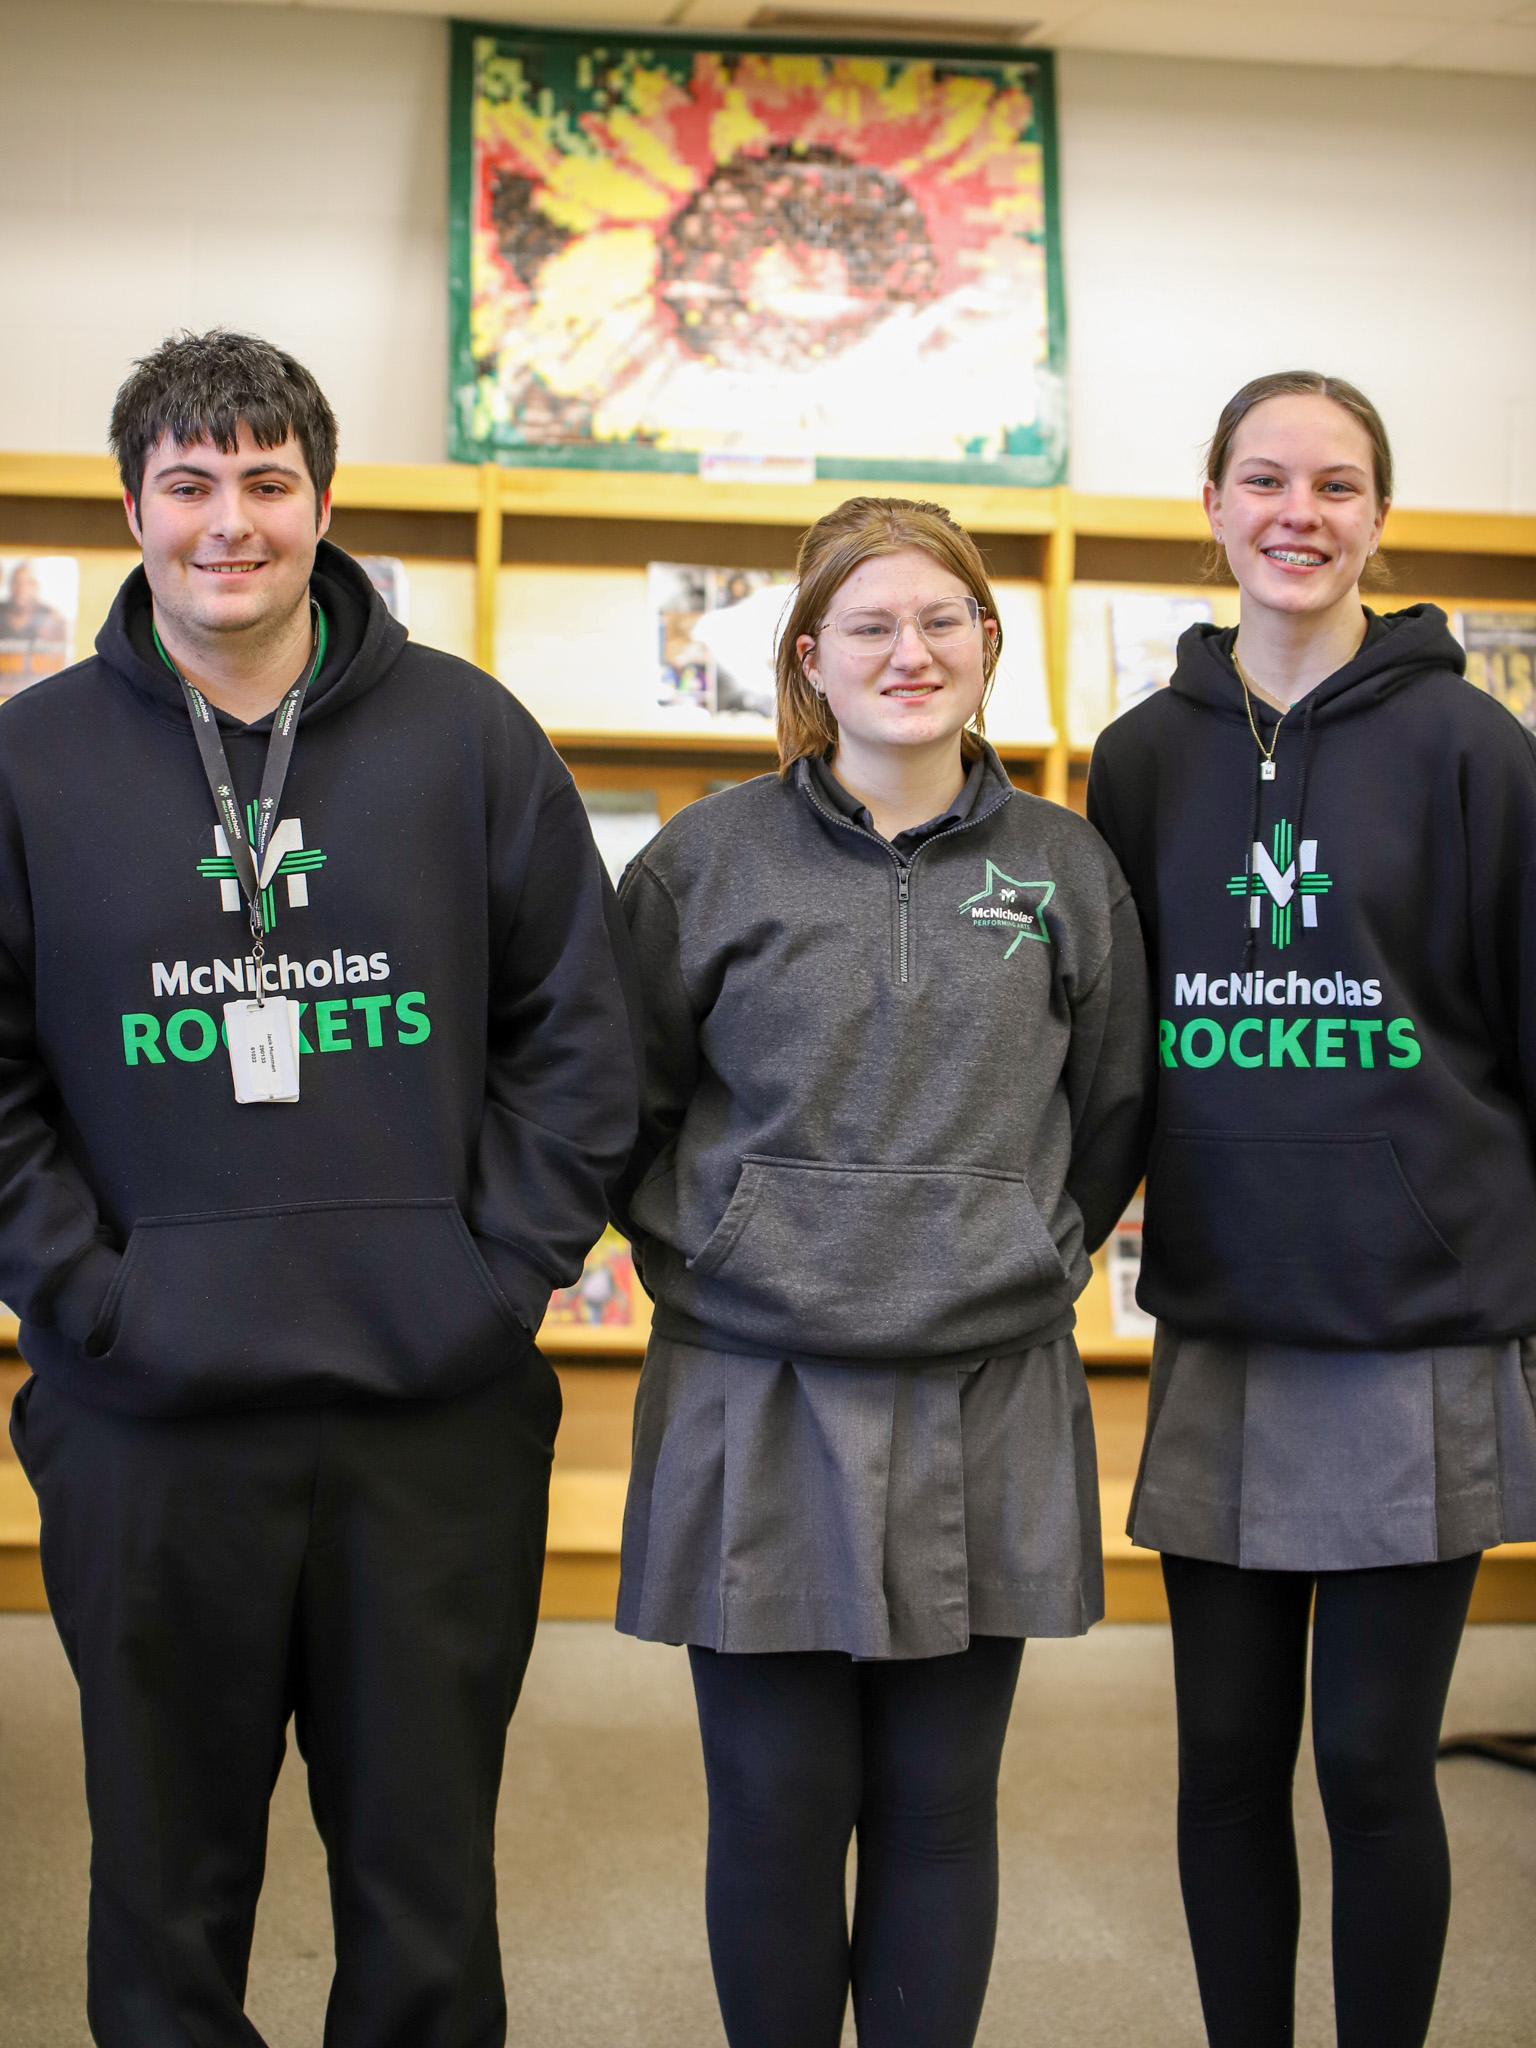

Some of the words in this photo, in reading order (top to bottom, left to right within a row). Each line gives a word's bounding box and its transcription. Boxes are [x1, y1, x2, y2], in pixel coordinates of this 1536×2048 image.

[193, 699, 202, 718] SCHOOL
[278, 711, 287, 728] SCHOOL
[282, 700, 298, 736] McNicholas
[225, 813, 234, 833] SCHOOL
[227, 799, 242, 839] McNicholas
[260, 812, 271, 853] McNicholas
[972, 907, 1034, 923] McNicholas
[151, 948, 391, 996] McNicholas
[1174, 970, 1383, 1007] McNicholas
[121, 990, 431, 1066] ROETS
